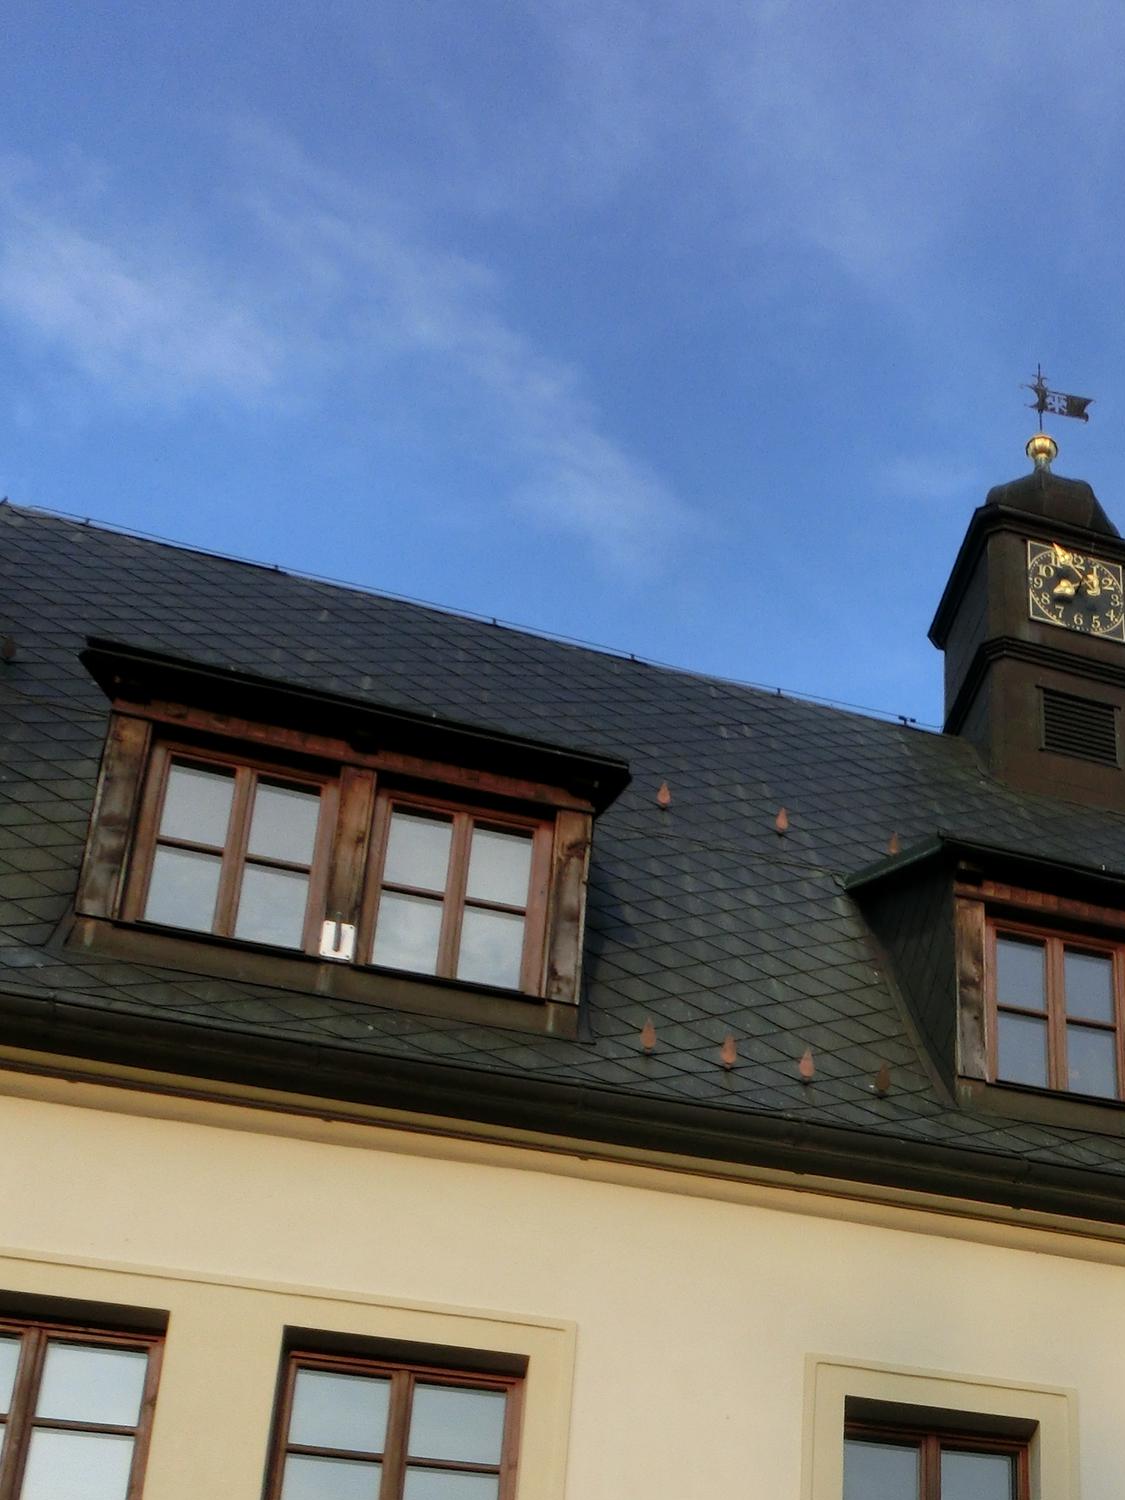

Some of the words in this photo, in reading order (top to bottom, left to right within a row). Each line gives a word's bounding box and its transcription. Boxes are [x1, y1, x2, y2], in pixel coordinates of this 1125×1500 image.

[1038, 564, 1054, 578] 10
[1033, 577, 1043, 588] 9
[1102, 577, 1114, 591] 2
[1041, 592, 1050, 604] 8
[1111, 594, 1120, 607] 3
[1055, 605, 1064, 618] 7
[1105, 609, 1115, 622] 4
[1073, 613, 1083, 625] 6
[1091, 615, 1100, 629] 5
